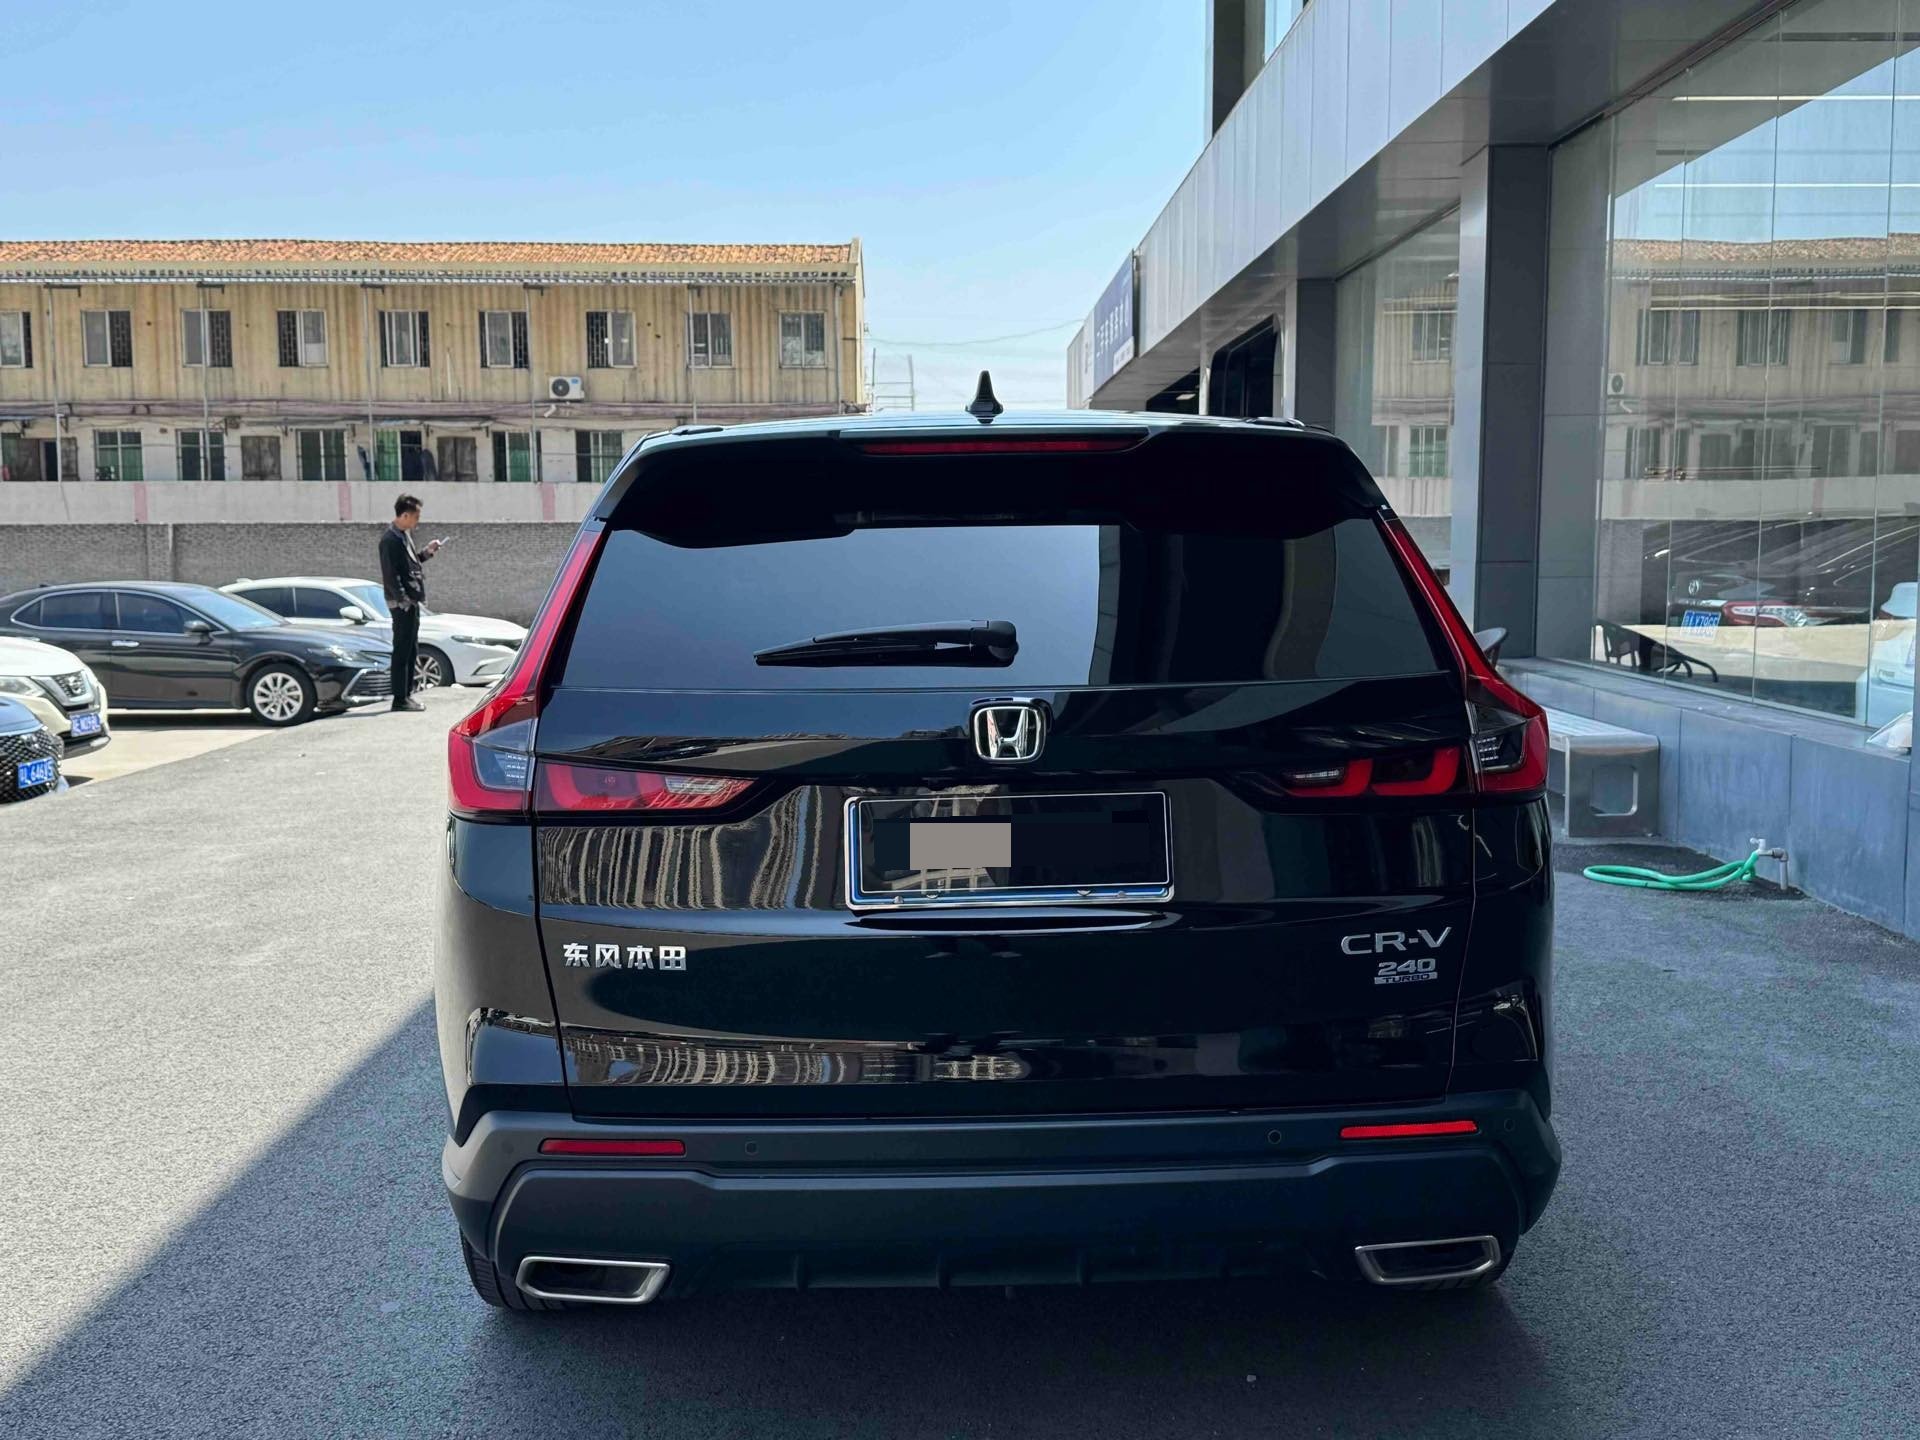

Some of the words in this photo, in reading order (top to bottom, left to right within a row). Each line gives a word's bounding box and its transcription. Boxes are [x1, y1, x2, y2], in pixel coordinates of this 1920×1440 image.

[1340, 926, 1452, 955] CR-V
[562, 942, 687, 971] 东风本田
[1378, 958, 1437, 976] 240
[1382, 973, 1433, 983] TURBO
